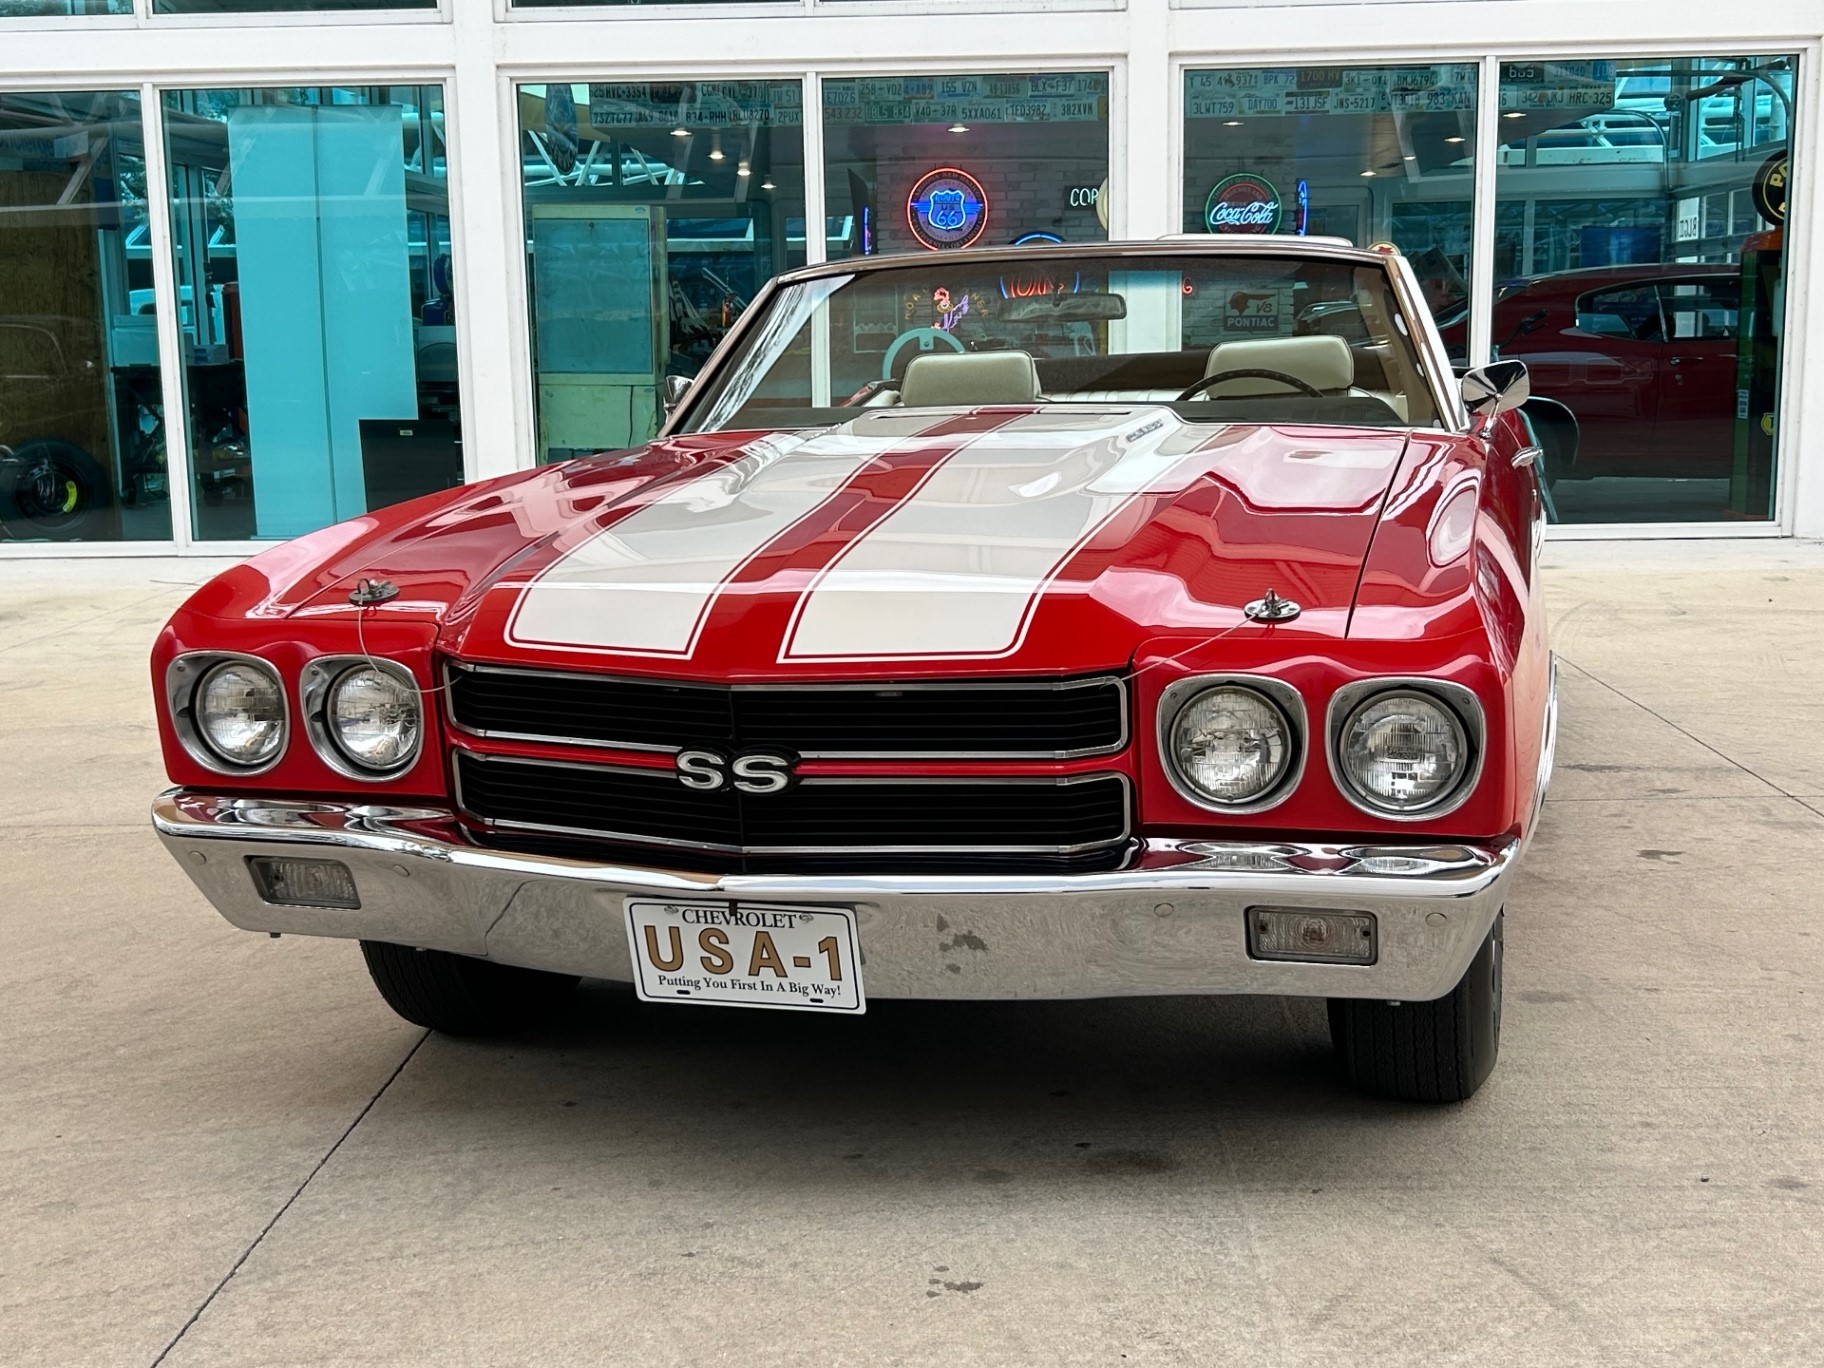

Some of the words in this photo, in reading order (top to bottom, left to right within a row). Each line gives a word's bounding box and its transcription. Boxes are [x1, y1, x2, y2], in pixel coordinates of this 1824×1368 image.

[936, 211, 957, 226] 66
[1210, 202, 1278, 225] Coca-Cola
[1256, 301, 1272, 313] V8
[1227, 317, 1275, 327] PONTIAC
[677, 751, 788, 793] SS
[682, 908, 797, 929] CHEVROLET
[658, 975, 701, 990] Putting
[703, 977, 728, 989] You
[731, 979, 757, 991] First
[760, 980, 774, 991] In
[776, 982, 786, 992] A
[789, 982, 809, 996] Big
[810, 983, 841, 998] Way!
